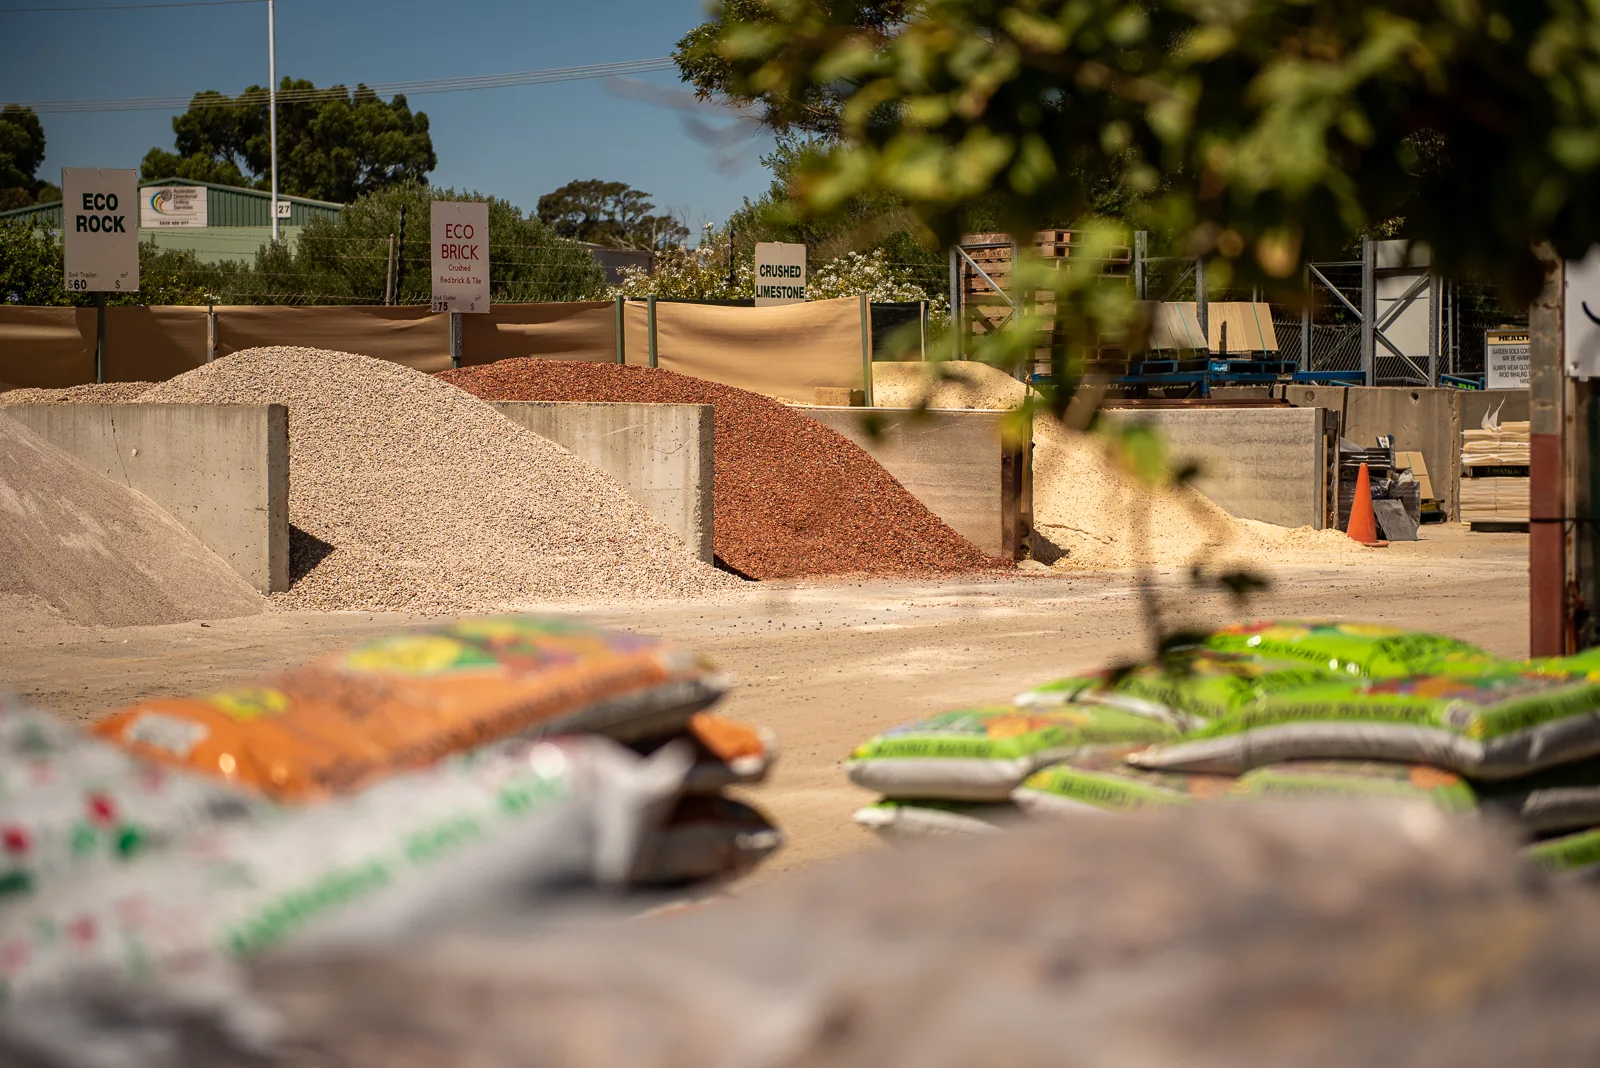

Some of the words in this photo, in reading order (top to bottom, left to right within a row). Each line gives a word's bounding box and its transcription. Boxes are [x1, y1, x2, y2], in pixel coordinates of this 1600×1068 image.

[82, 193, 119, 211] ECO
[278, 205, 290, 214] 27
[76, 215, 126, 233] ROCK
[445, 223, 475, 240] ECO
[441, 243, 480, 260] BRICK
[448, 264, 471, 272] Crushed
[759, 264, 801, 278] CRUSHED
[67, 279, 87, 290] $60
[471, 277, 482, 285] Tile
[755, 285, 805, 299] LIMESTONE
